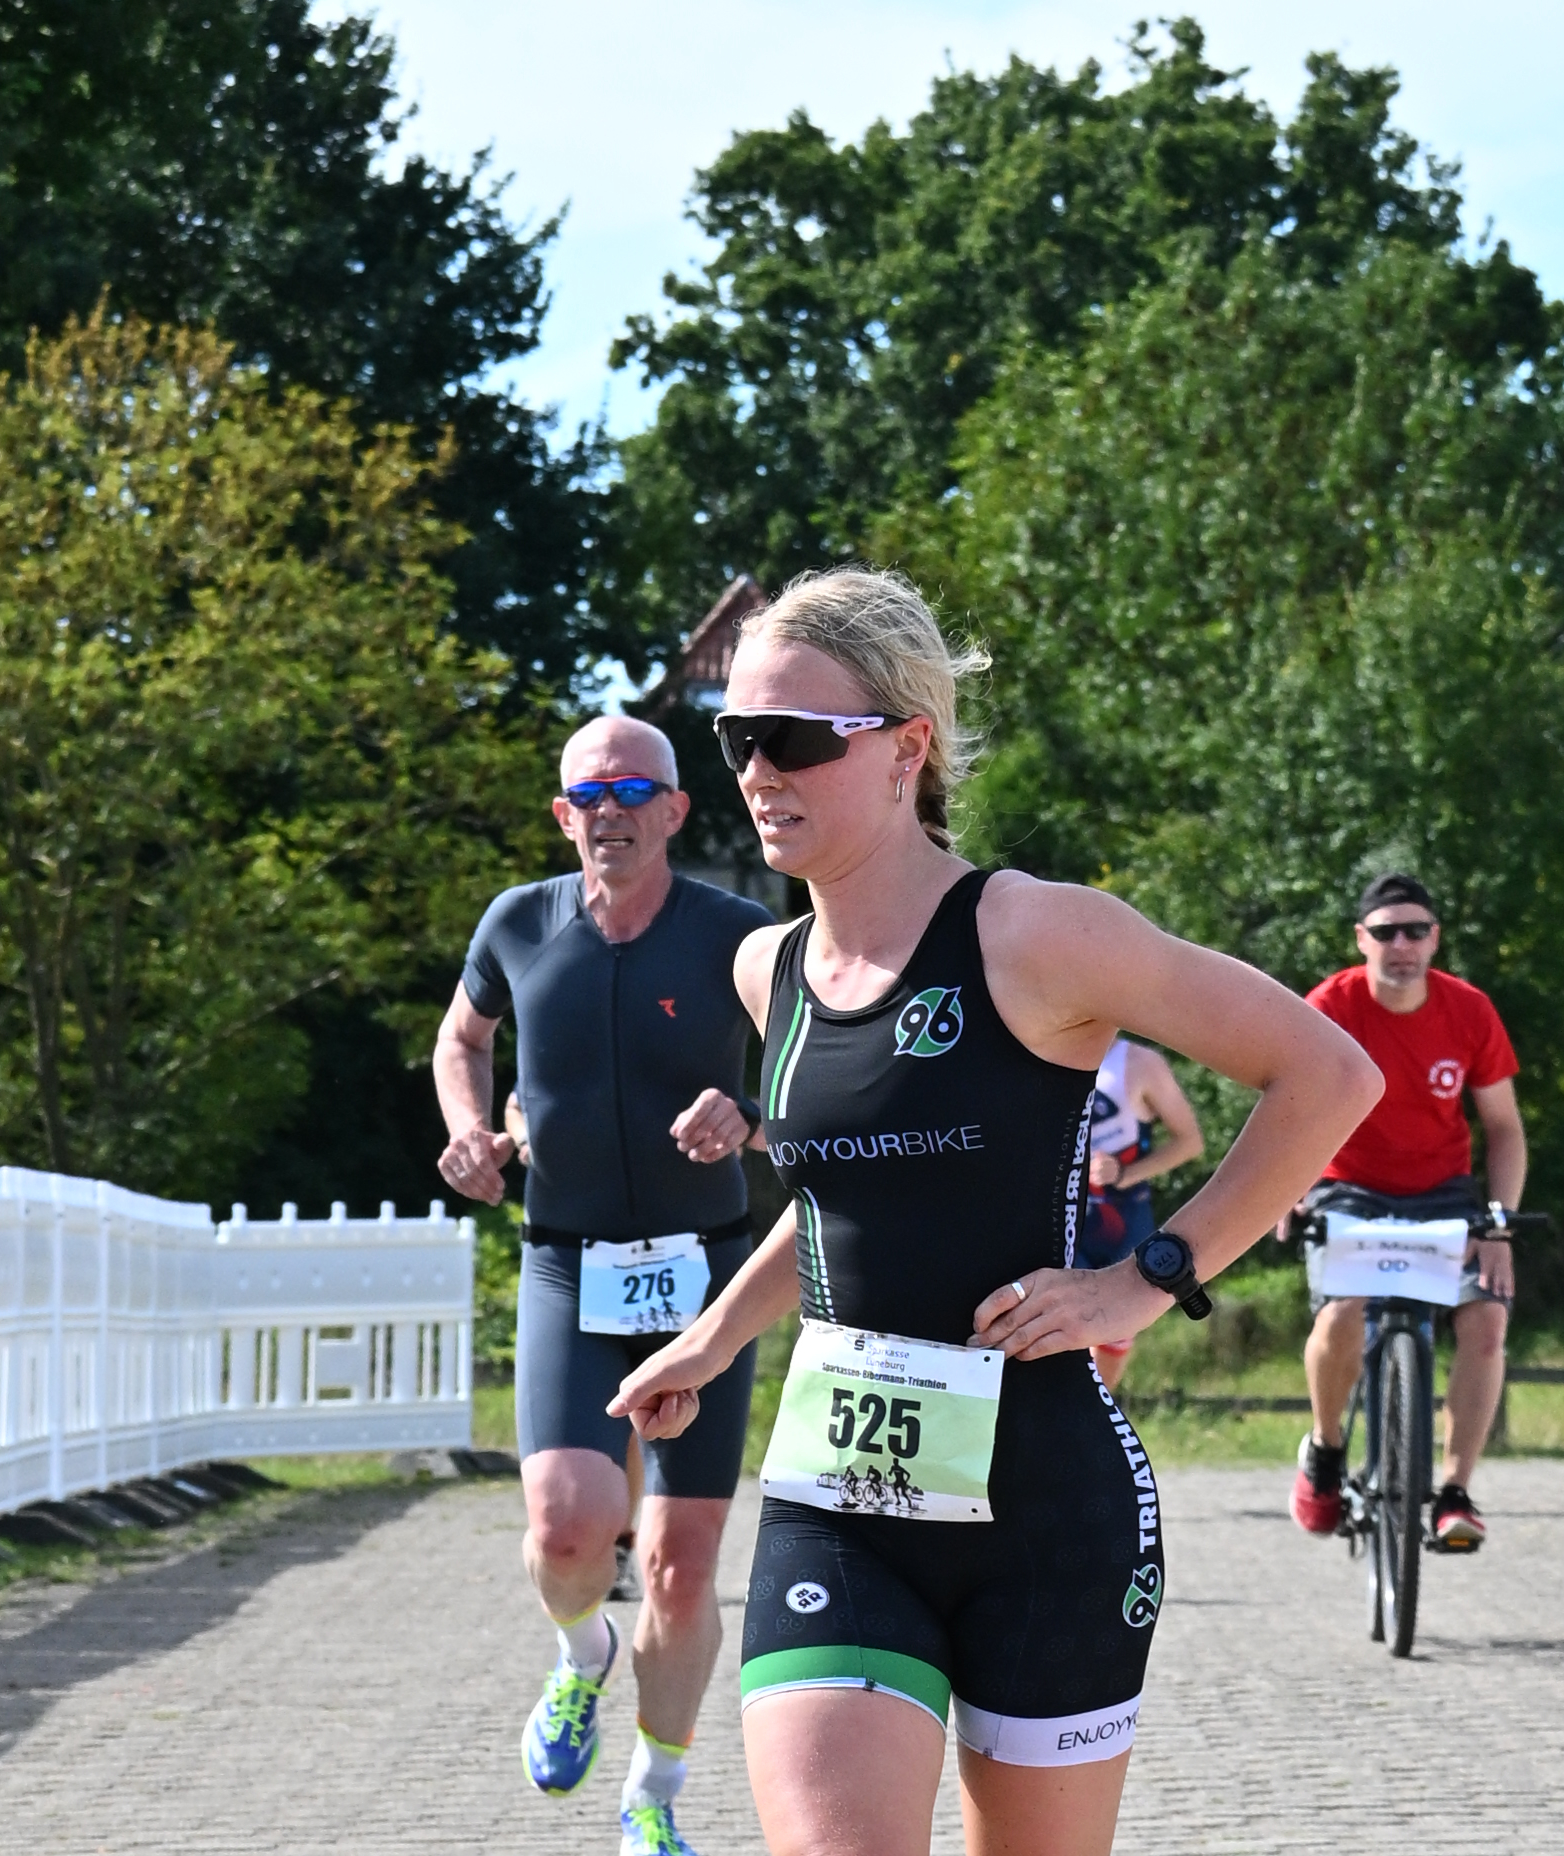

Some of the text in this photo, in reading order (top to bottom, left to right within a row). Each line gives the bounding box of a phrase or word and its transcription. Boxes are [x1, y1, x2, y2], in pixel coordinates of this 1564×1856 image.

[894, 986, 965, 1058] 96
[623, 1267, 676, 1305] 276
[827, 1387, 923, 1460] 525
[1122, 1563, 1163, 1628] 96
[1057, 1706, 1140, 1751] ENJOYY
